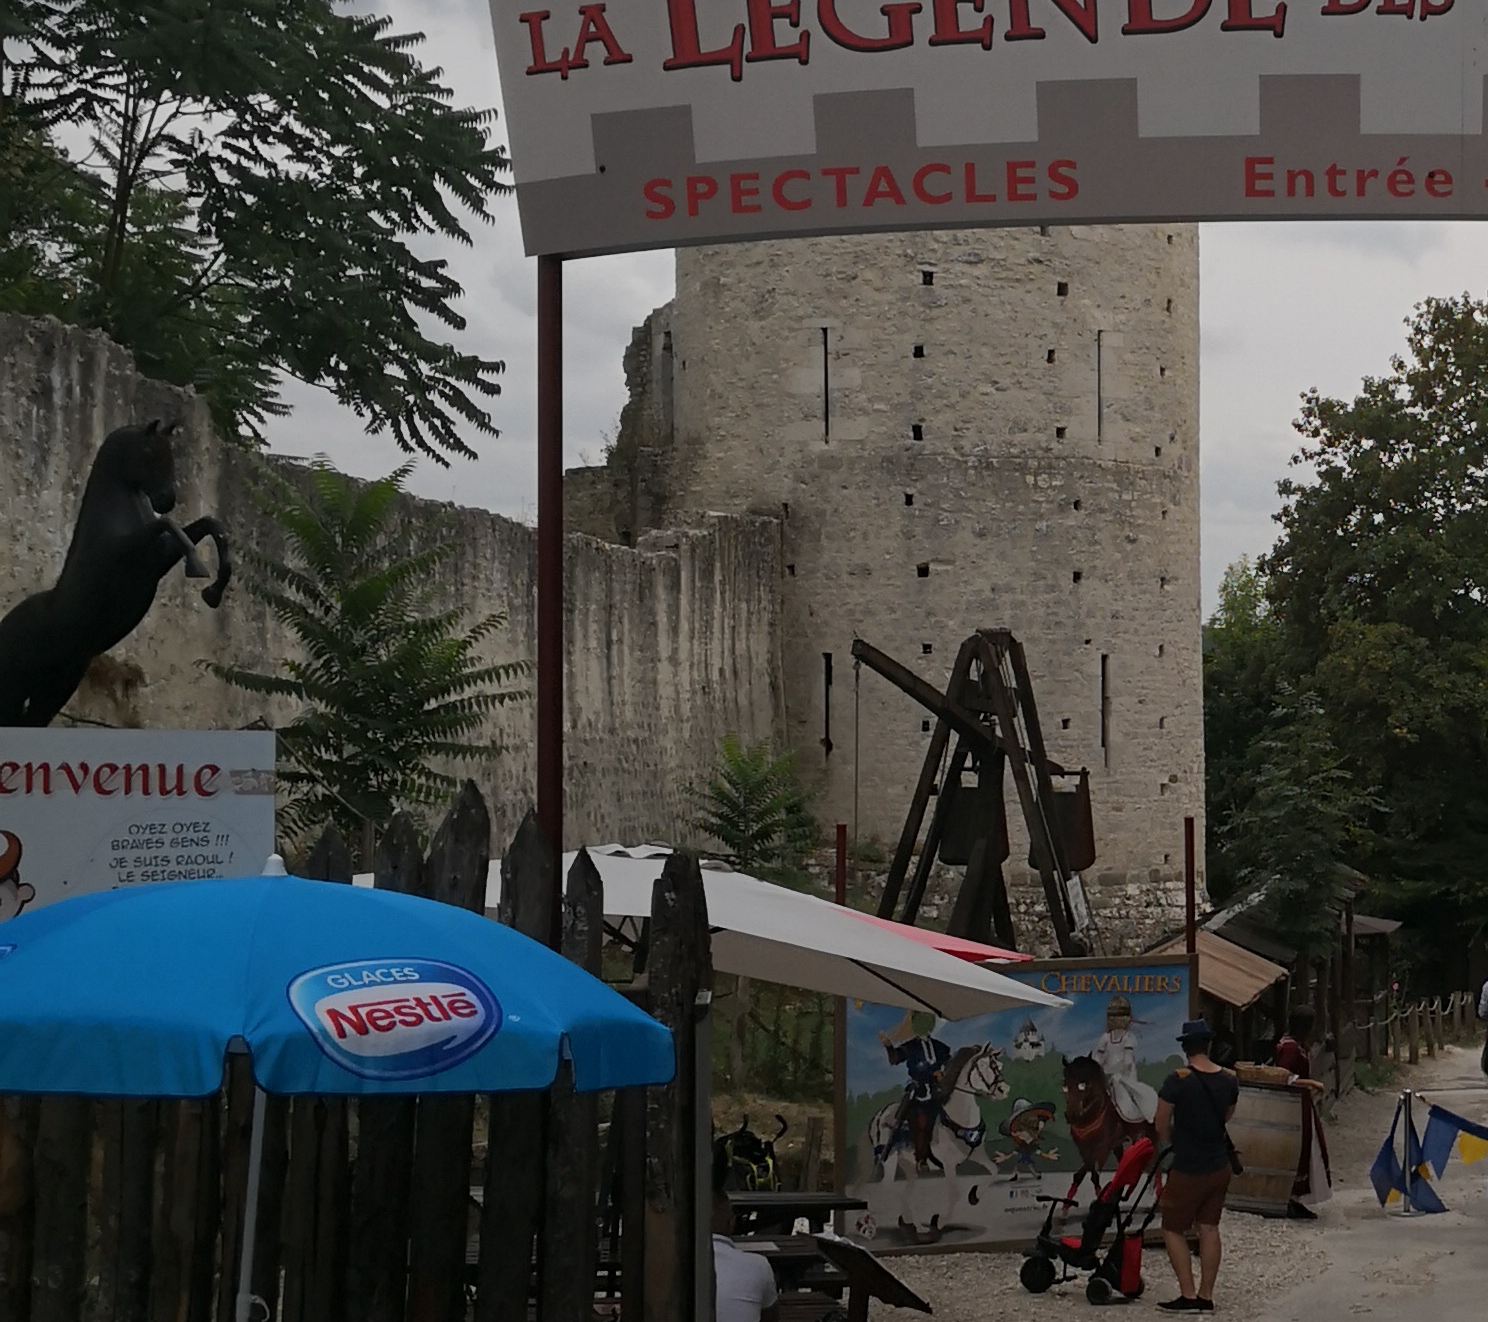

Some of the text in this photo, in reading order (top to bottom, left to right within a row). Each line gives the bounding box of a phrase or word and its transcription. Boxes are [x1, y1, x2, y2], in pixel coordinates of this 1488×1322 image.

[519, 3, 632, 80] LA
[1243, 157, 1456, 201] Entrée
[643, 160, 1080, 222] SPECTACLES
[128, 821, 211, 836] OYEZ OYEZ
[110, 837, 165, 851] BRAVES
[169, 835, 210, 849] GENS
[109, 856, 128, 869] JE
[133, 855, 171, 867] SUIS
[176, 853, 224, 866] RAOUL
[118, 870, 136, 883] LE
[326, 967, 421, 989] GLACES
[1041, 971, 1183, 995] CHEVALIERS
[326, 992, 478, 1039] Nestlé
